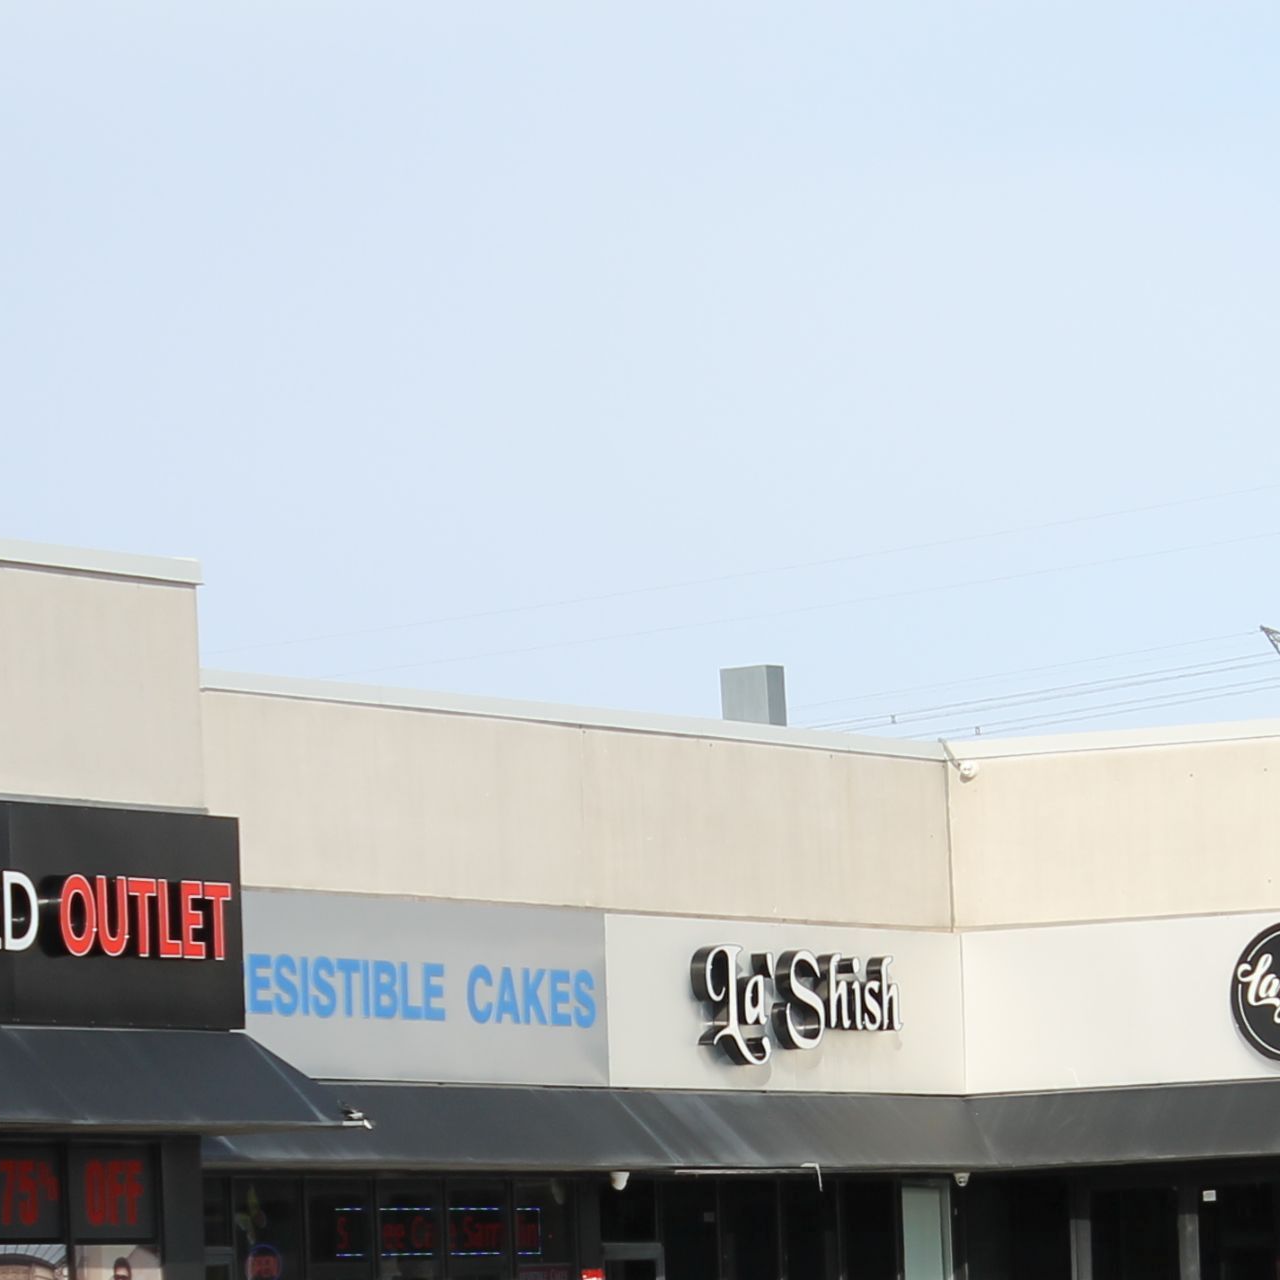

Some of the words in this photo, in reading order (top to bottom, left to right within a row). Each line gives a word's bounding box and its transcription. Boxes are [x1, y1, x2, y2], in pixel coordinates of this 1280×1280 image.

[59, 873, 232, 961] OUTLET
[245, 953, 446, 1021] ESISTIBLE
[466, 964, 597, 1028] CAKES
[85, 1158, 144, 1227] OFF
